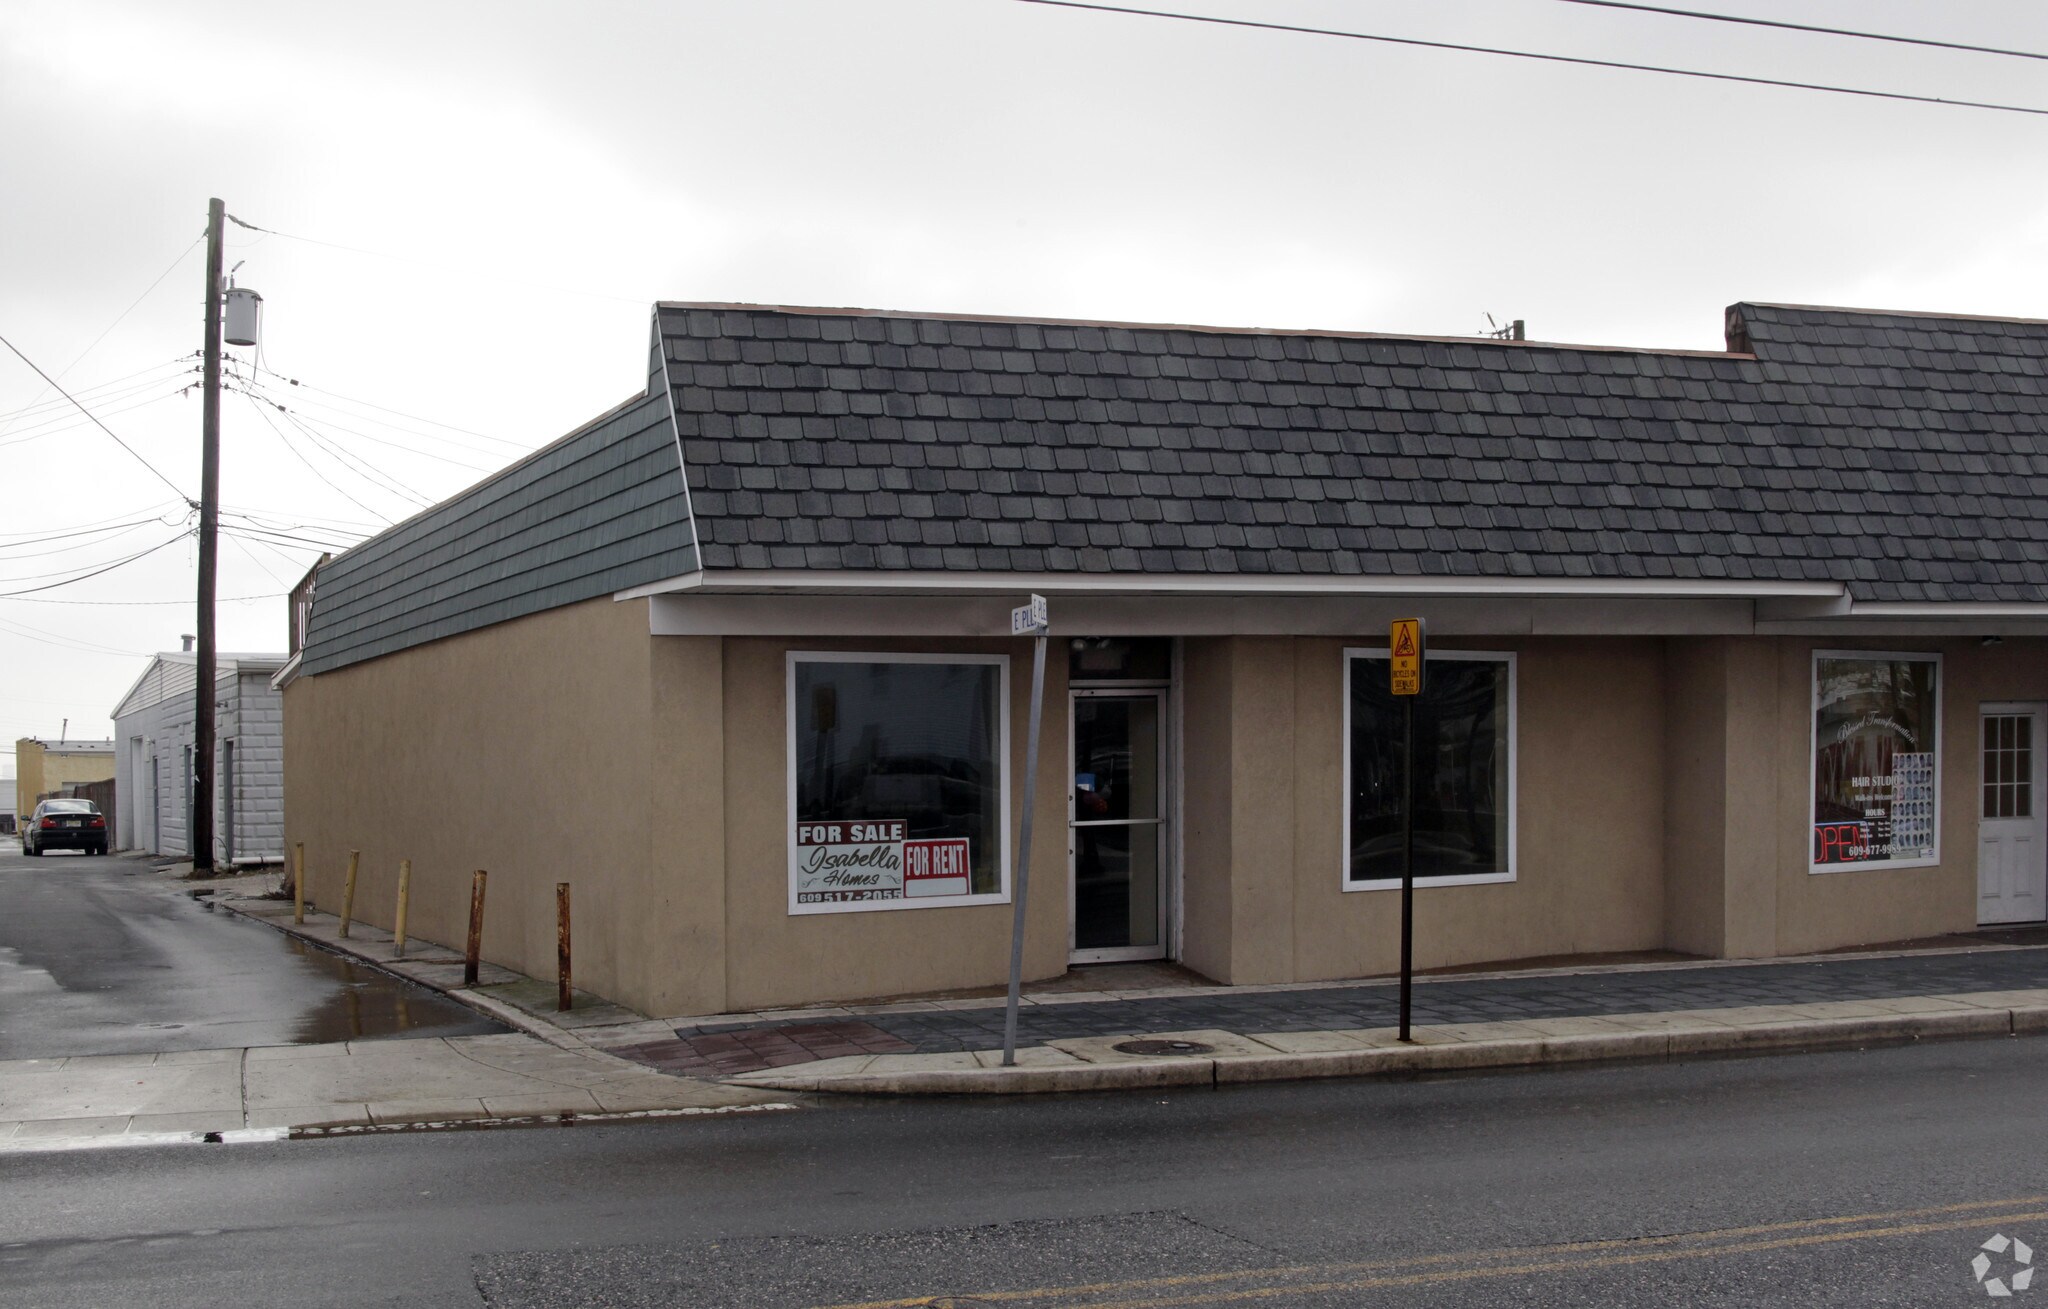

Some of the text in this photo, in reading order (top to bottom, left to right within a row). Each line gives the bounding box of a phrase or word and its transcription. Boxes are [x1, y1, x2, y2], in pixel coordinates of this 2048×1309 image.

[1015, 612, 1019, 630] E
[1401, 660, 1407, 668] NO
[1852, 775, 1899, 787] HAIR STUDIO
[1865, 808, 1885, 816] HOURS
[800, 824, 902, 843] FOR SALE
[801, 846, 901, 874] Isabella
[907, 845, 964, 876] FOR RENT
[823, 869, 880, 887] Homes
[800, 893, 821, 903] 609
